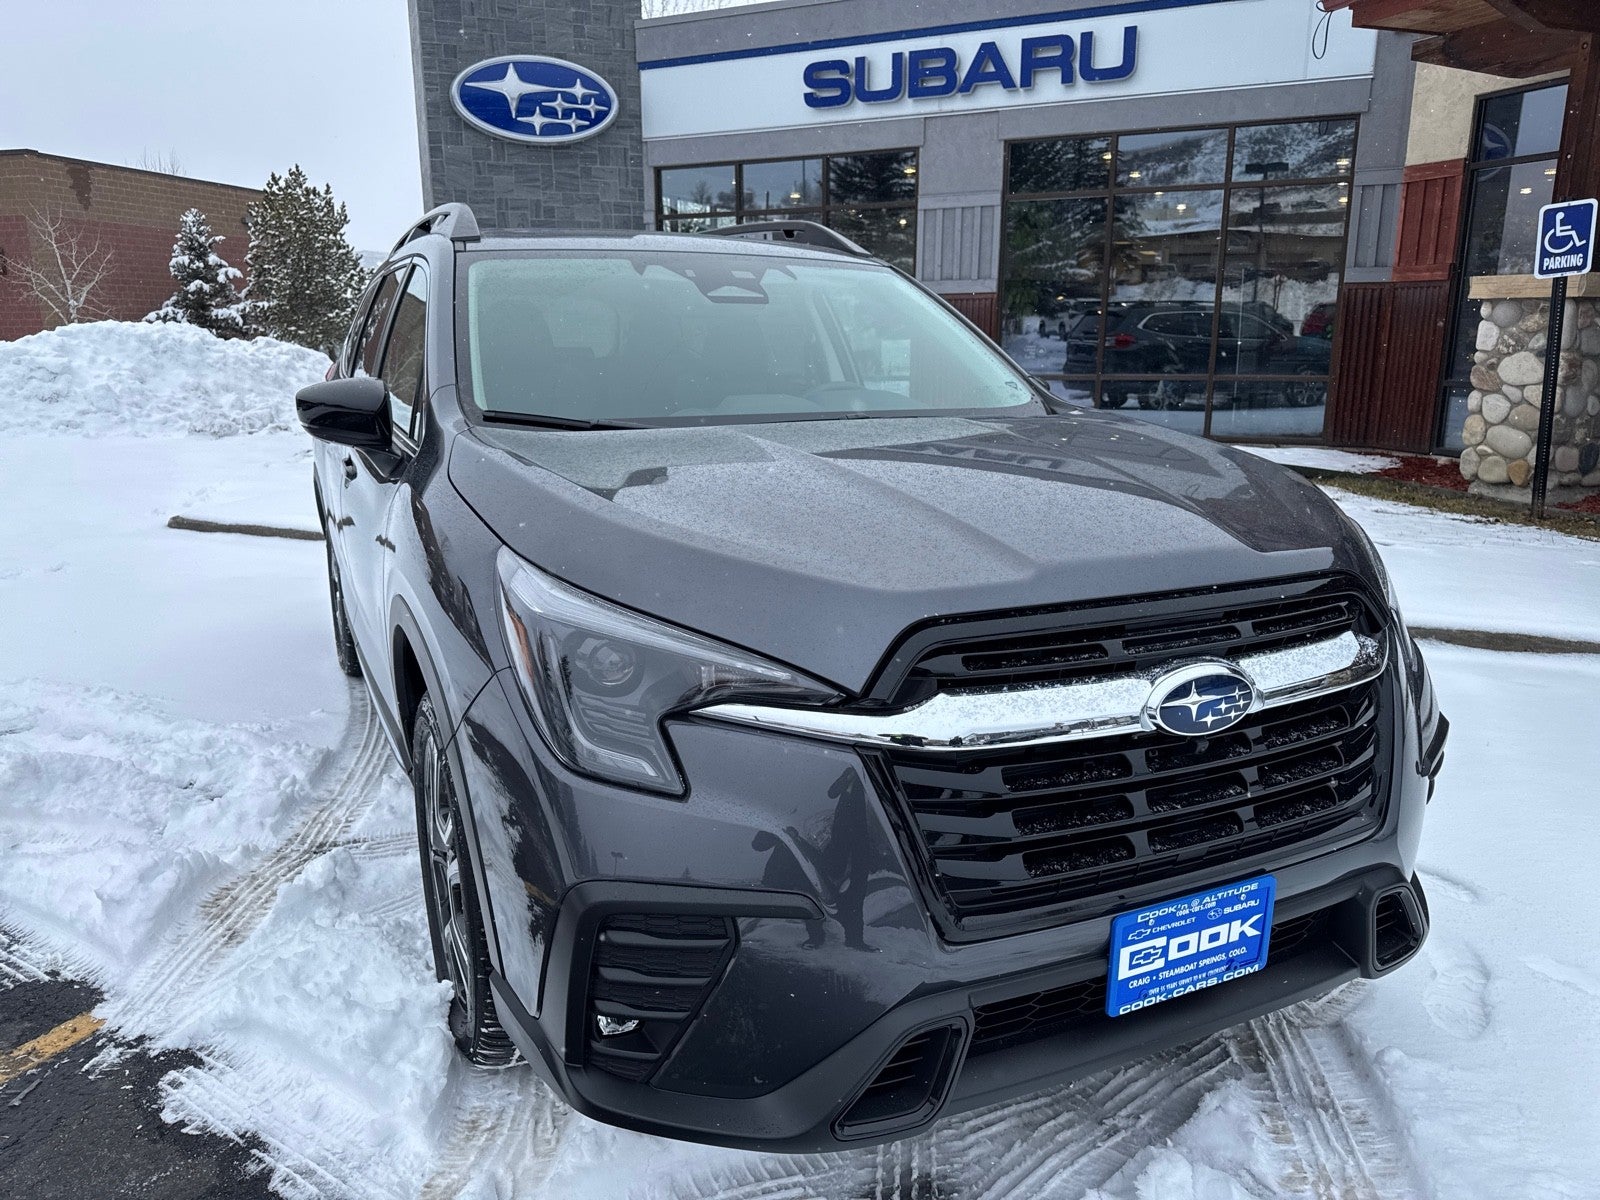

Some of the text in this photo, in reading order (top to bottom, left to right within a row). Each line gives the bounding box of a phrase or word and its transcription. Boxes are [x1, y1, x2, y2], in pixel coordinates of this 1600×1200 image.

[803, 25, 1138, 109] SUBARU
[1543, 253, 1583, 270] PARKING
[1202, 882, 1259, 905] ALTITUDE
[1223, 899, 1260, 915] SUBARU
[1152, 916, 1196, 933] CHEVROLET
[1118, 913, 1264, 981] COOK
[1129, 976, 1151, 989] CRAIG
[1158, 962, 1197, 981] STEAMBOAT
[1119, 964, 1260, 1015] COOK-CARS.COM
